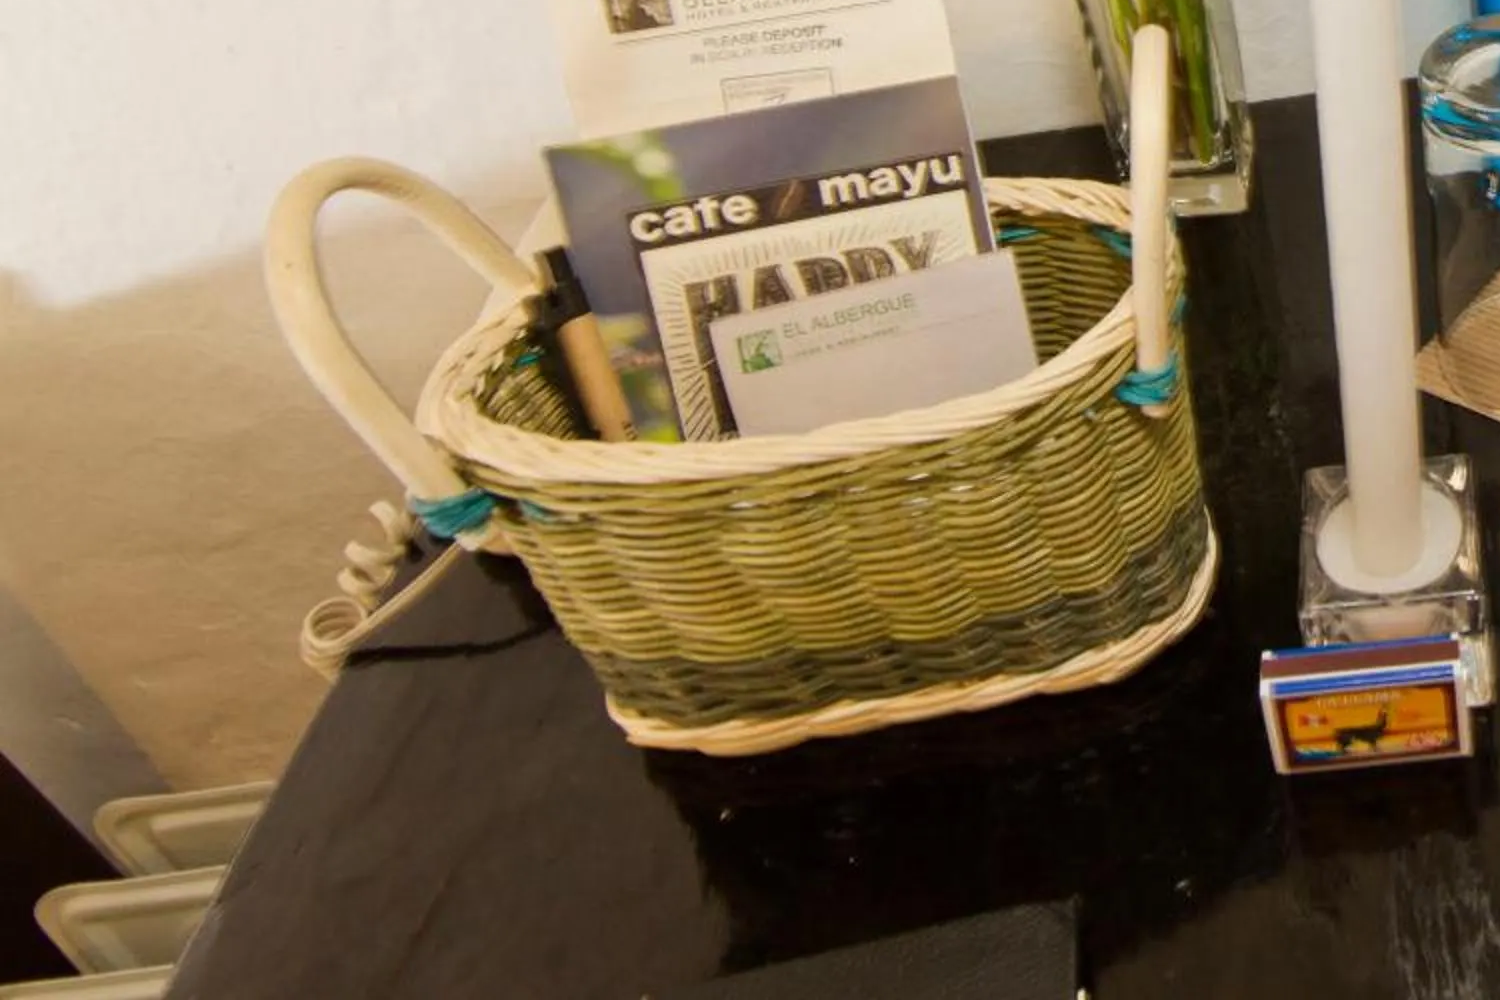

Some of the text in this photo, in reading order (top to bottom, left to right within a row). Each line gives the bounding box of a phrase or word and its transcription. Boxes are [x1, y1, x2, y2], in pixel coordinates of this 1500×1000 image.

[703, 23, 828, 49] PLEASE DEPOSIT
[629, 154, 965, 243] cafe mayu
[782, 292, 918, 340] EL ALBERGUE
